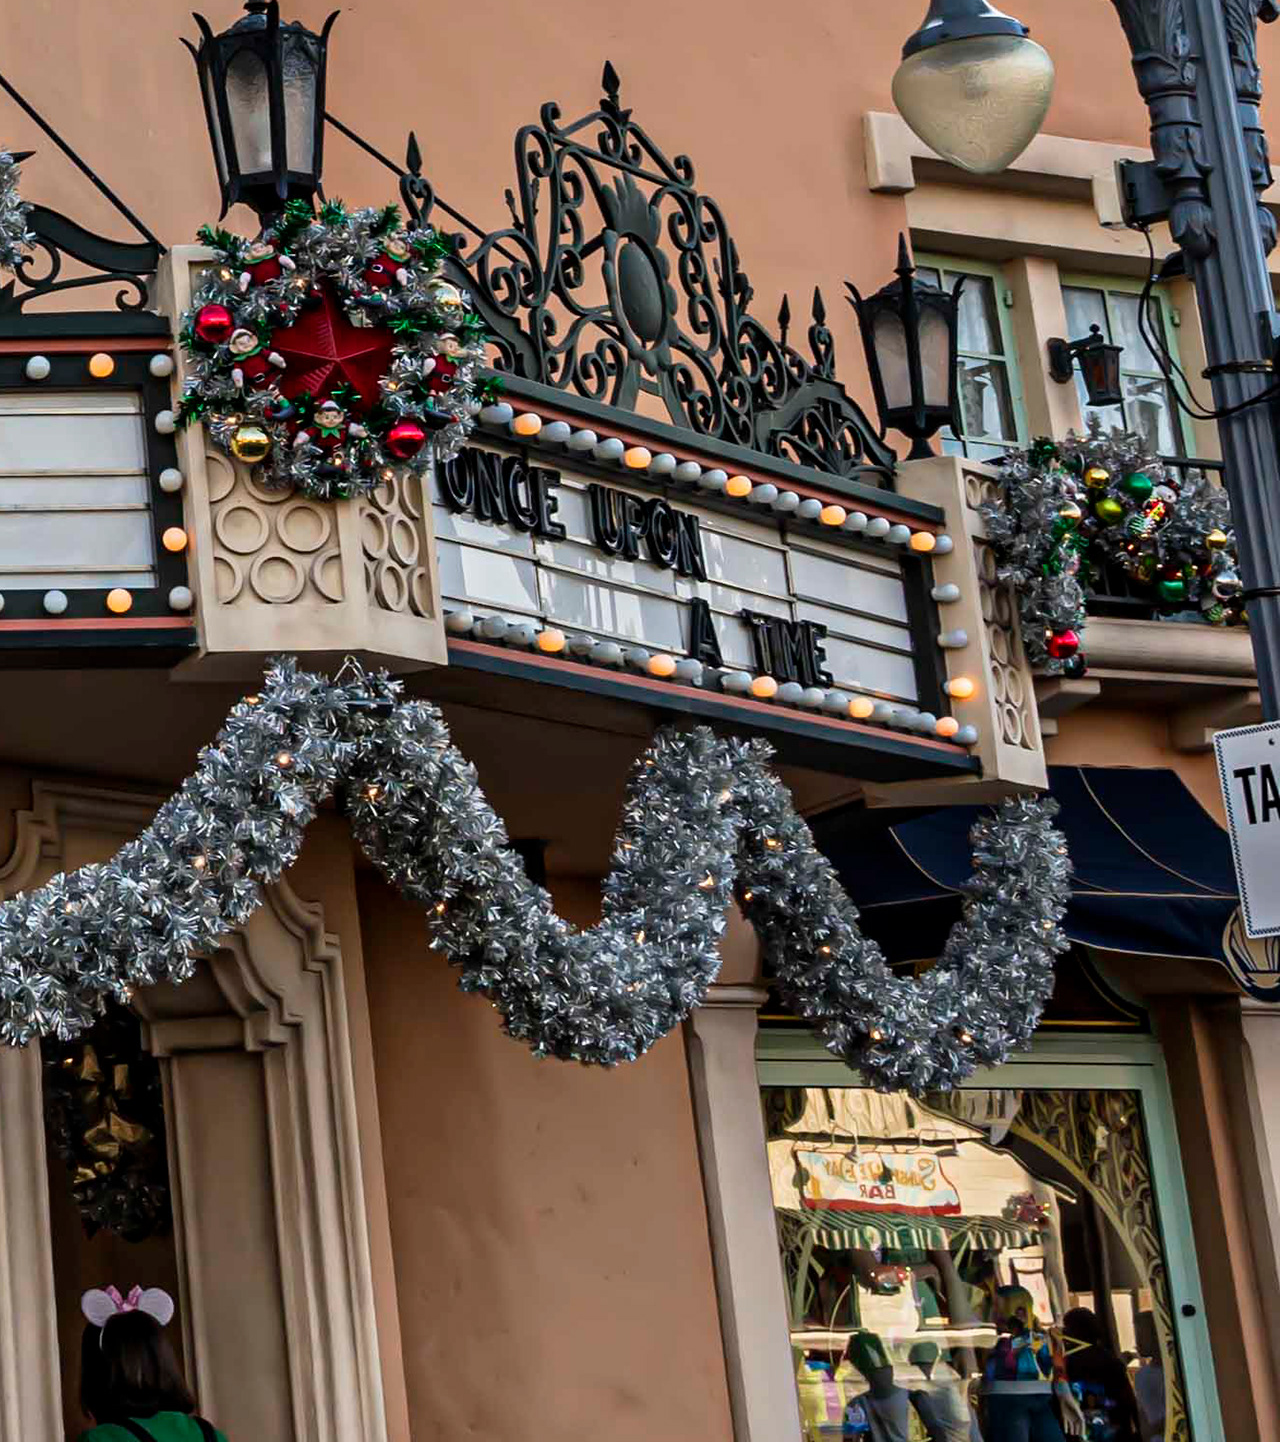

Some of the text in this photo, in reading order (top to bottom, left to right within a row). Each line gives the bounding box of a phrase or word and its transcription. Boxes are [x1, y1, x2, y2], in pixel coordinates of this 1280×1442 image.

[440, 446, 708, 583] ONCE UPON
[688, 596, 835, 689] A TIME
